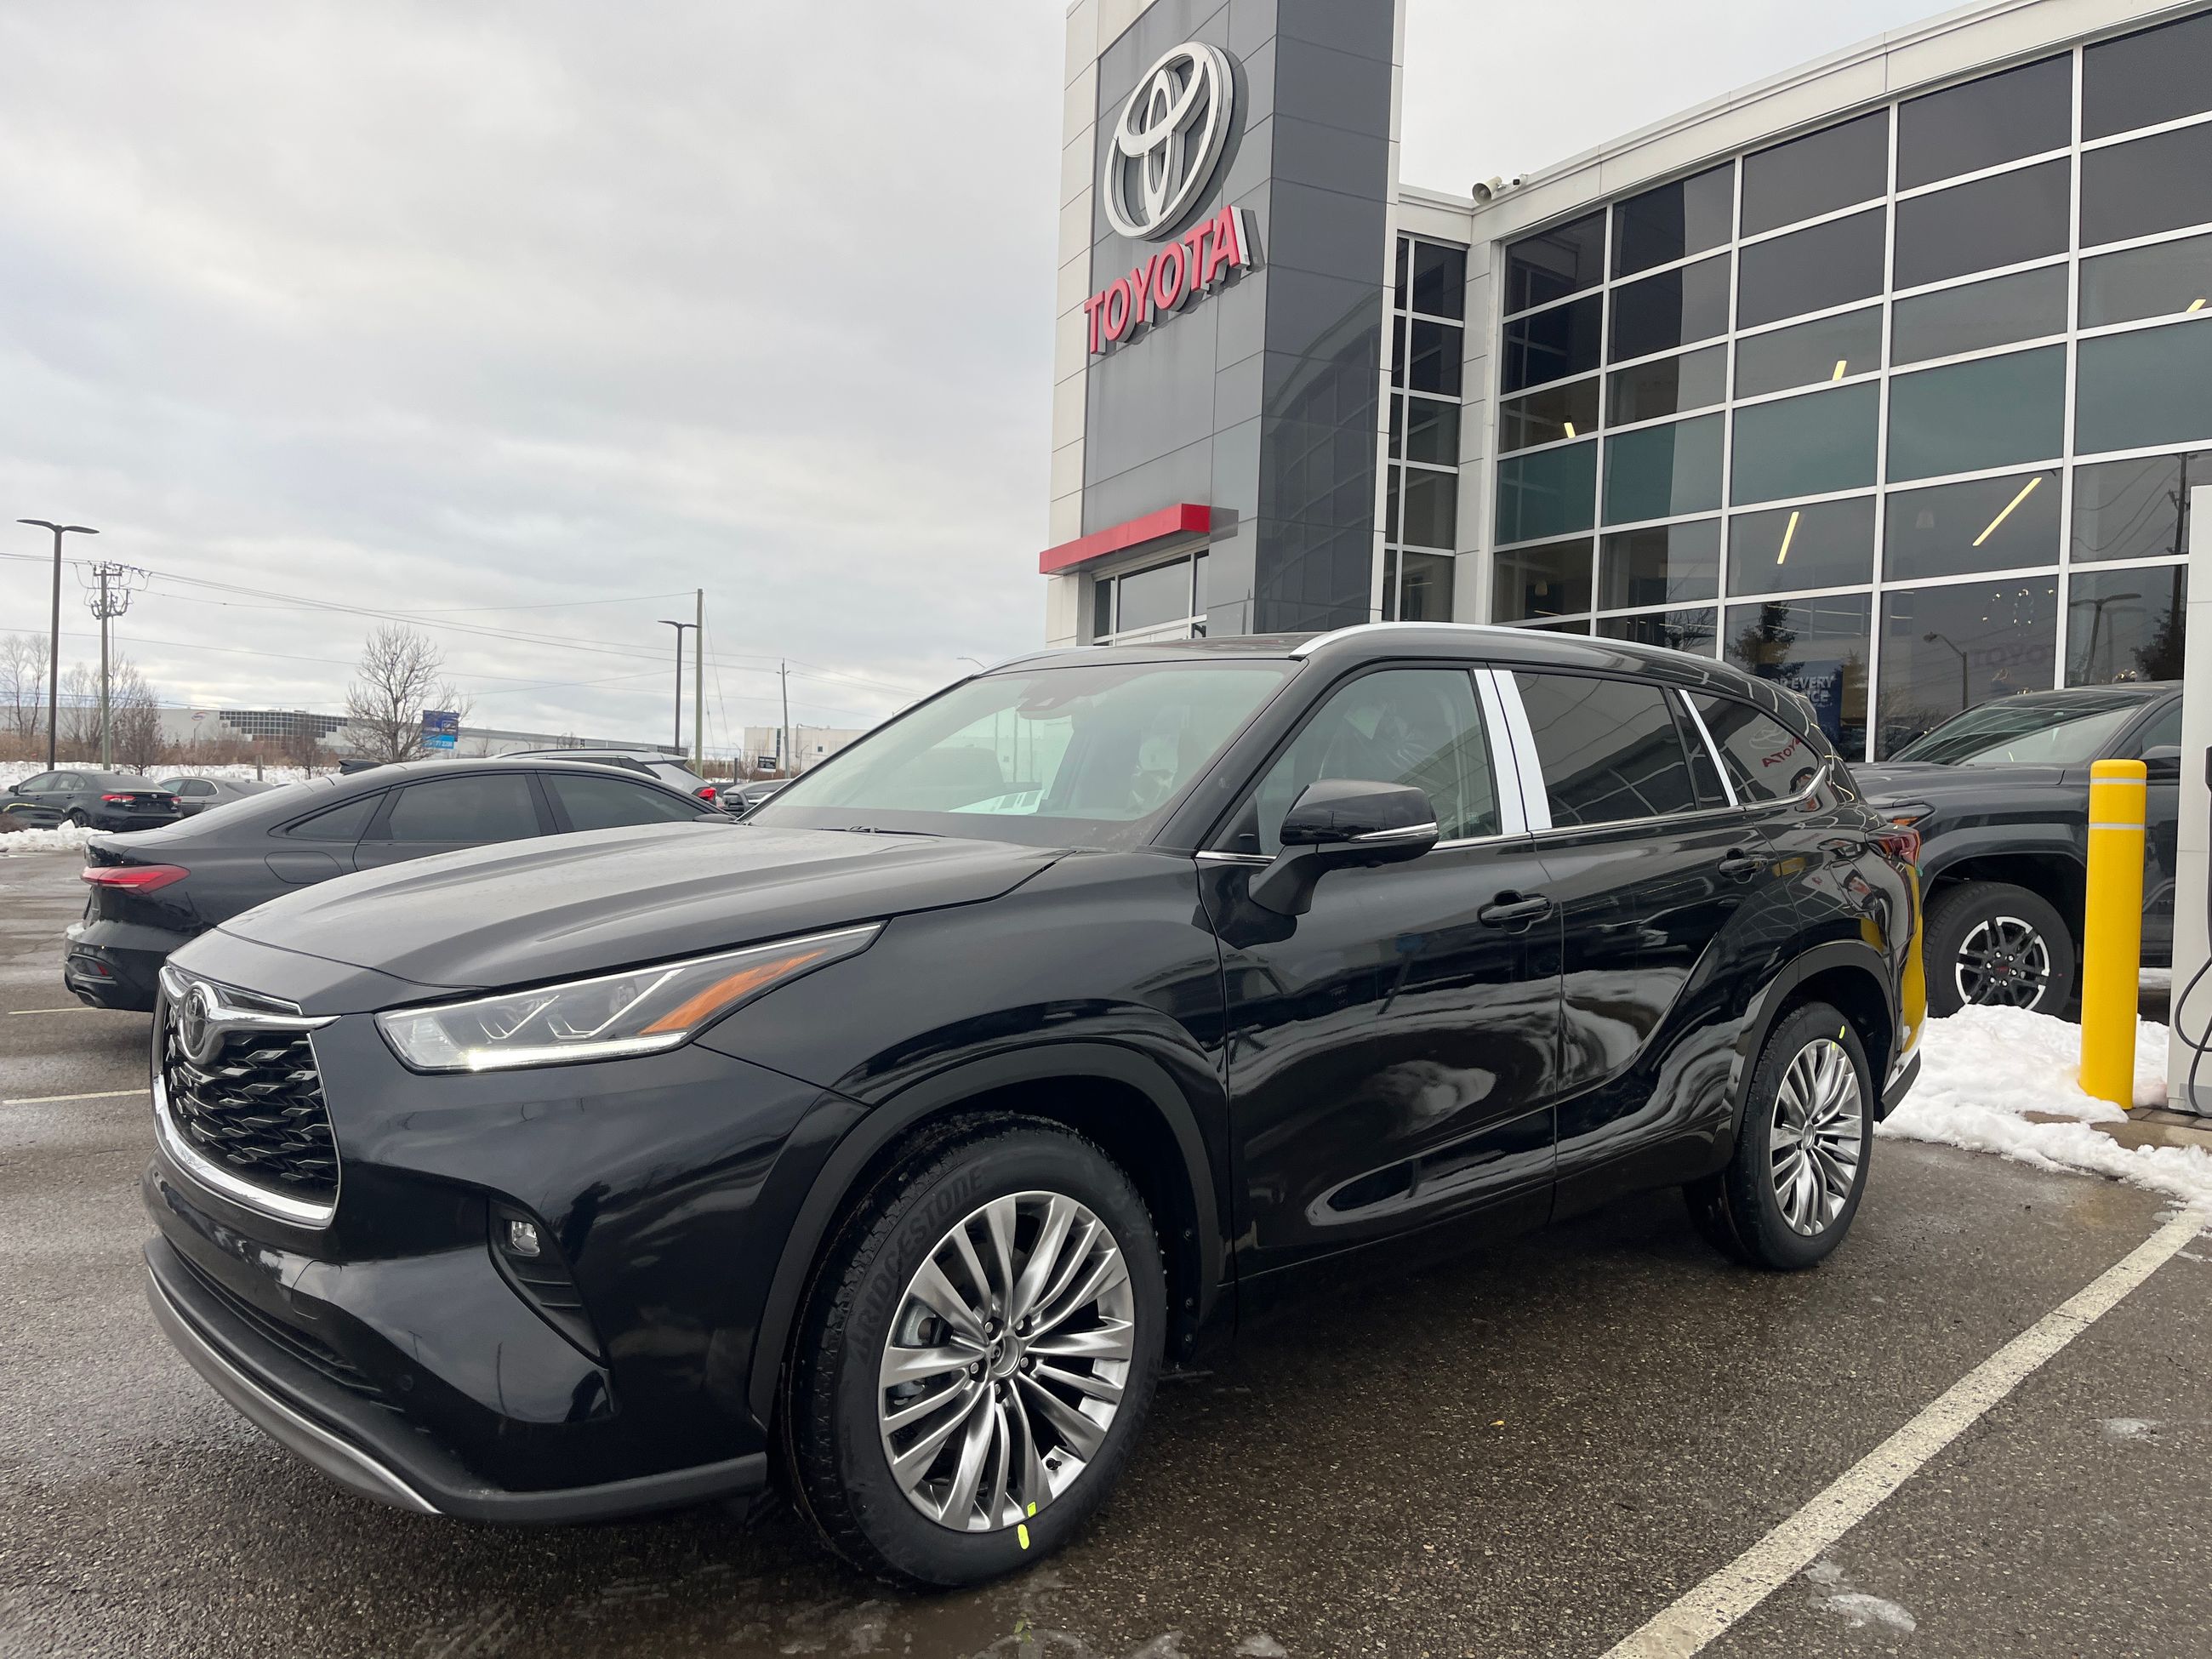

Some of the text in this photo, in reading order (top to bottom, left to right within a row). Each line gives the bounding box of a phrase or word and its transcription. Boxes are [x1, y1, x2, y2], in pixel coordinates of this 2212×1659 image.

[1084, 205, 1246, 355] TOYOTA
[1791, 676, 1833, 689] EVERY
[848, 1168, 984, 1360] BRIDGESTONE
